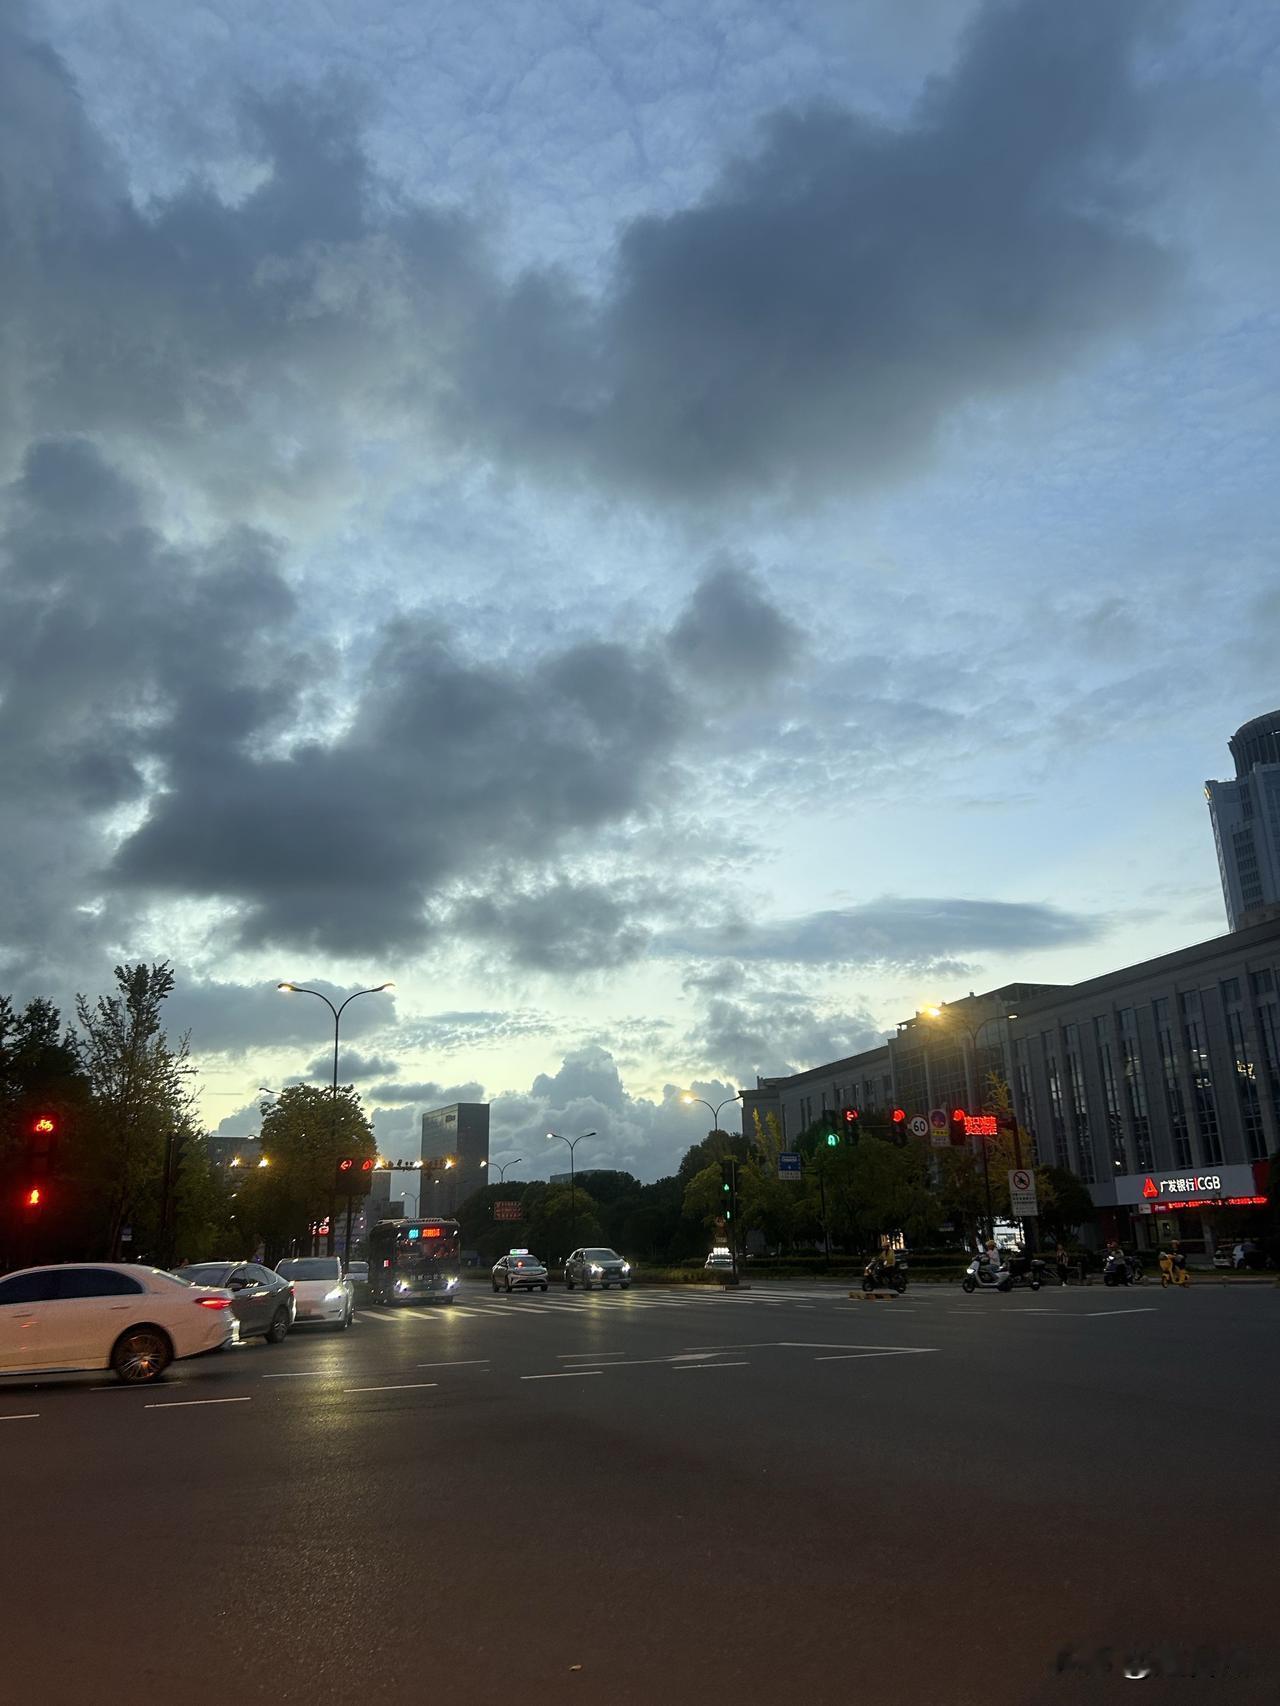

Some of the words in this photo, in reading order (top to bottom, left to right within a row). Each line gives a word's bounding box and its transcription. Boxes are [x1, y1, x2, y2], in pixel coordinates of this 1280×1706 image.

[913, 1120, 926, 1132] 60
[1160, 1178, 1195, 1193] 广发银行
[1197, 1175, 1221, 1191] CGB
